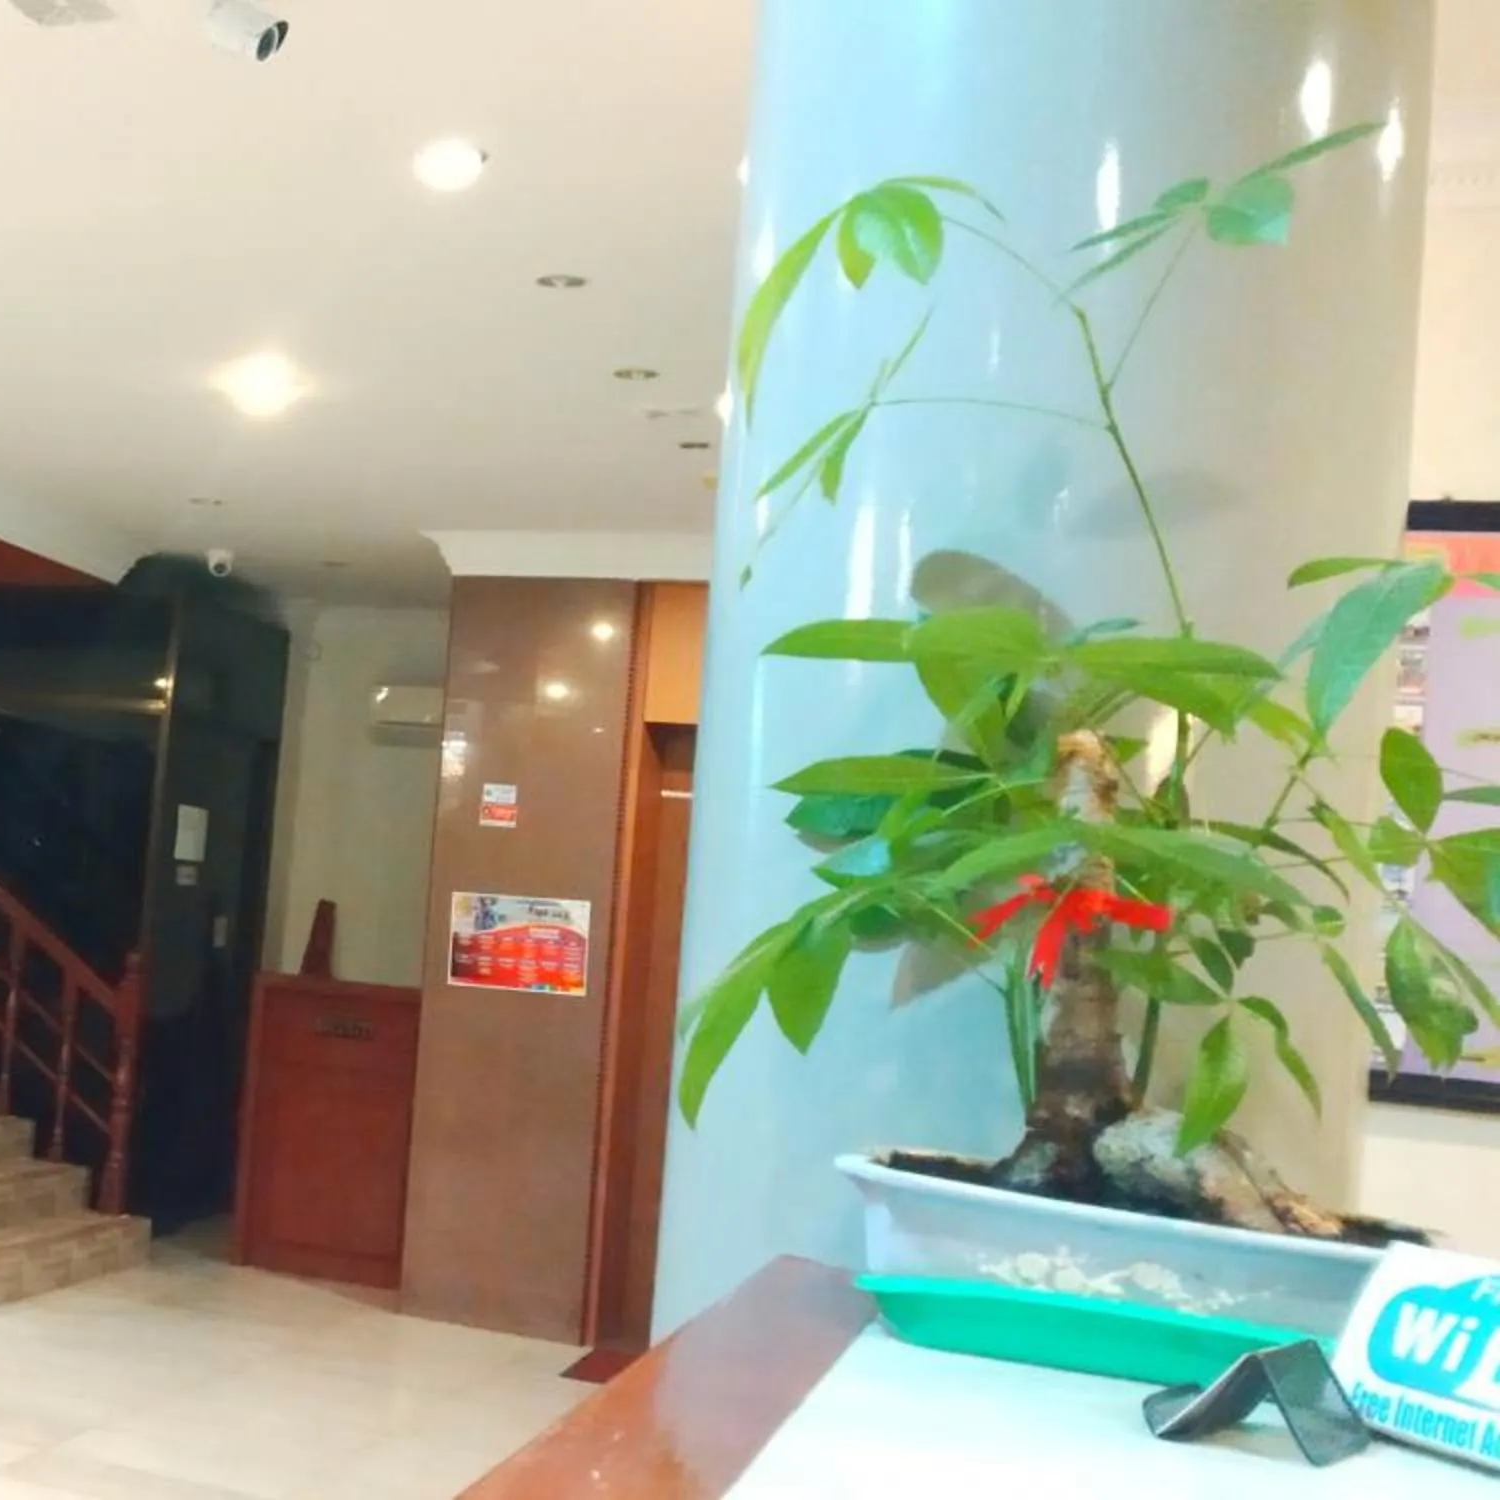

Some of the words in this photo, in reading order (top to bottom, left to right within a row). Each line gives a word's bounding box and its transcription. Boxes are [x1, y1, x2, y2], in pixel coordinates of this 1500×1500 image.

[1391, 1302, 1479, 1373] Wi
[1352, 1381, 1392, 1423] Free
[1393, 1396, 1478, 1449] Internet
[1479, 1419, 1500, 1456] A
